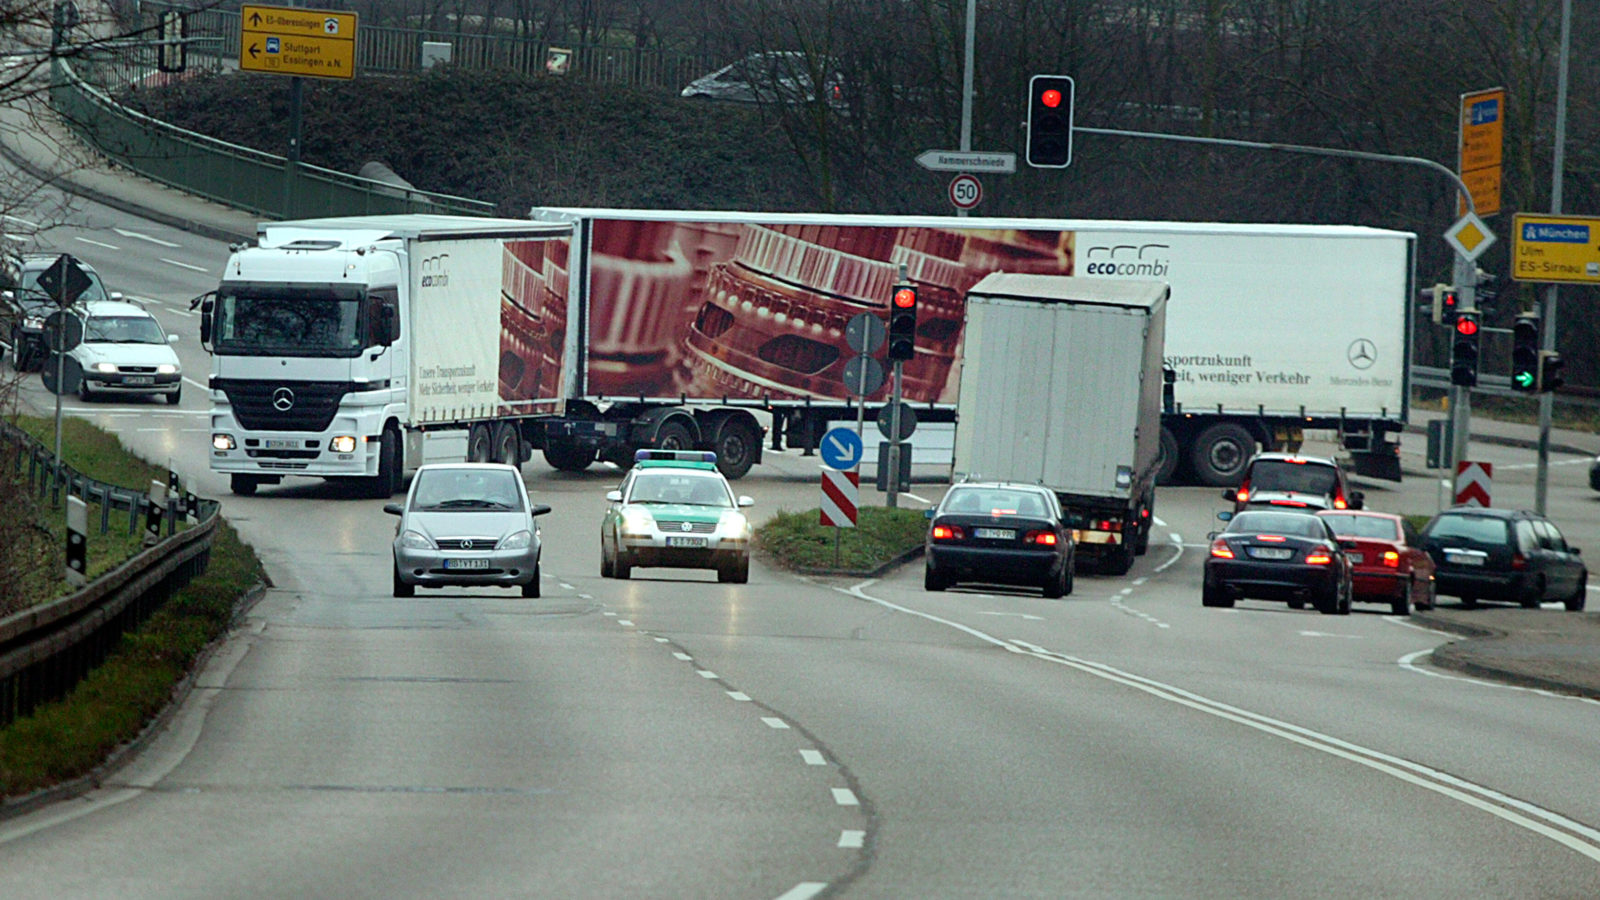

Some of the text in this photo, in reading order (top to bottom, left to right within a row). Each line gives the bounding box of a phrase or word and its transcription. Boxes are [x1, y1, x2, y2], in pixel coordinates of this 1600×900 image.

[284, 42, 320, 55] Stuttgart
[282, 55, 324, 67] Esslingen
[938, 155, 1005, 167] Hammerschmiede
[956, 183, 976, 199] 50
[1538, 227, 1588, 239] München
[1521, 245, 1544, 256] Ulm
[1087, 259, 1170, 276] ecocombi
[1520, 260, 1581, 273] ES-Sirnau
[421, 271, 448, 287] ecocombi
[1162, 353, 1252, 368] sportzukunft
[1198, 370, 1252, 385] weniger
[1256, 370, 1312, 384] Verkehr
